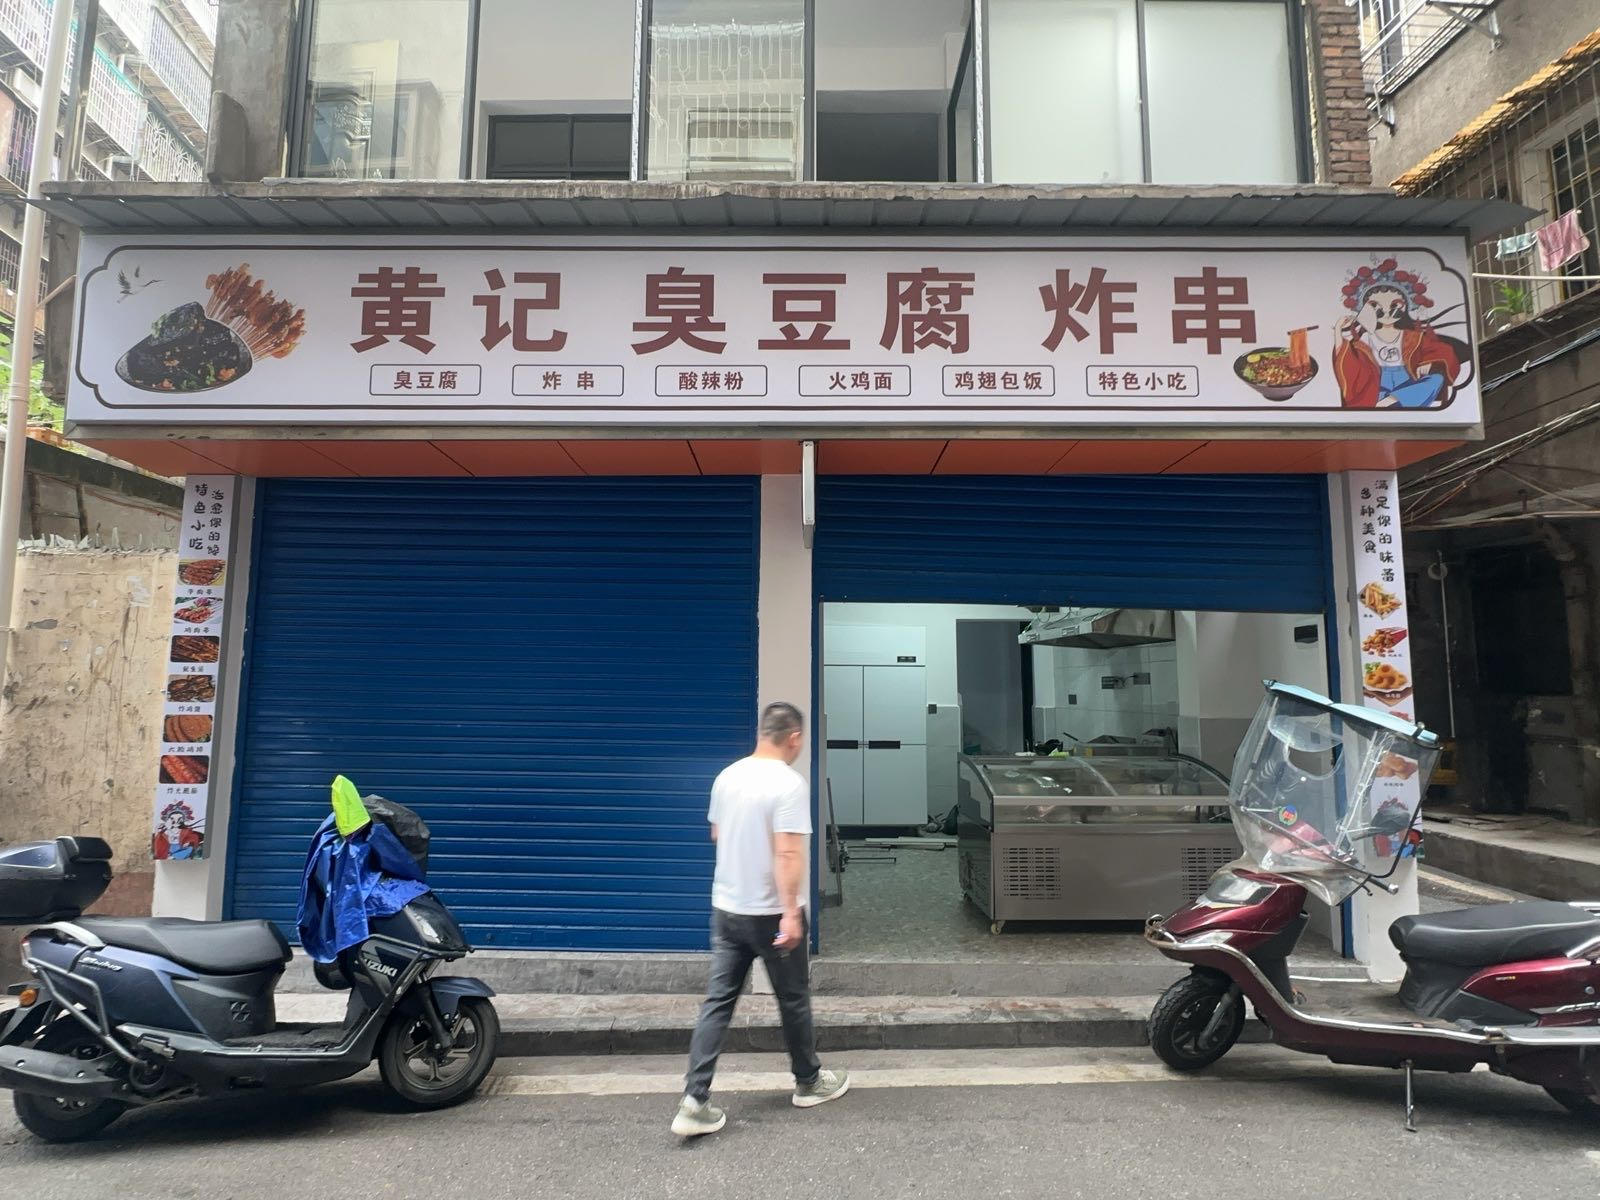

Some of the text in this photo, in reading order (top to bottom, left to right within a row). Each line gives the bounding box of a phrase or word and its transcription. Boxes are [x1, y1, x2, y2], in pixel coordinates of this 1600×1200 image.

[350, 266, 1257, 356] 黄记 臭豆腐 炸串
[393, 370, 458, 390] 臭豆腐
[542, 370, 595, 391] 炸串
[678, 371, 744, 391] 酸辣粉
[828, 371, 893, 391] 火鸡面
[954, 370, 1044, 391] 鸡翅包饭
[1099, 370, 1187, 391] 特色小吃
[189, 483, 208, 550] 特色小吃
[1359, 487, 1377, 554] 多种美食
[1374, 479, 1395, 582] 满足你的味蕾
[354, 958, 398, 977] UZUKI
